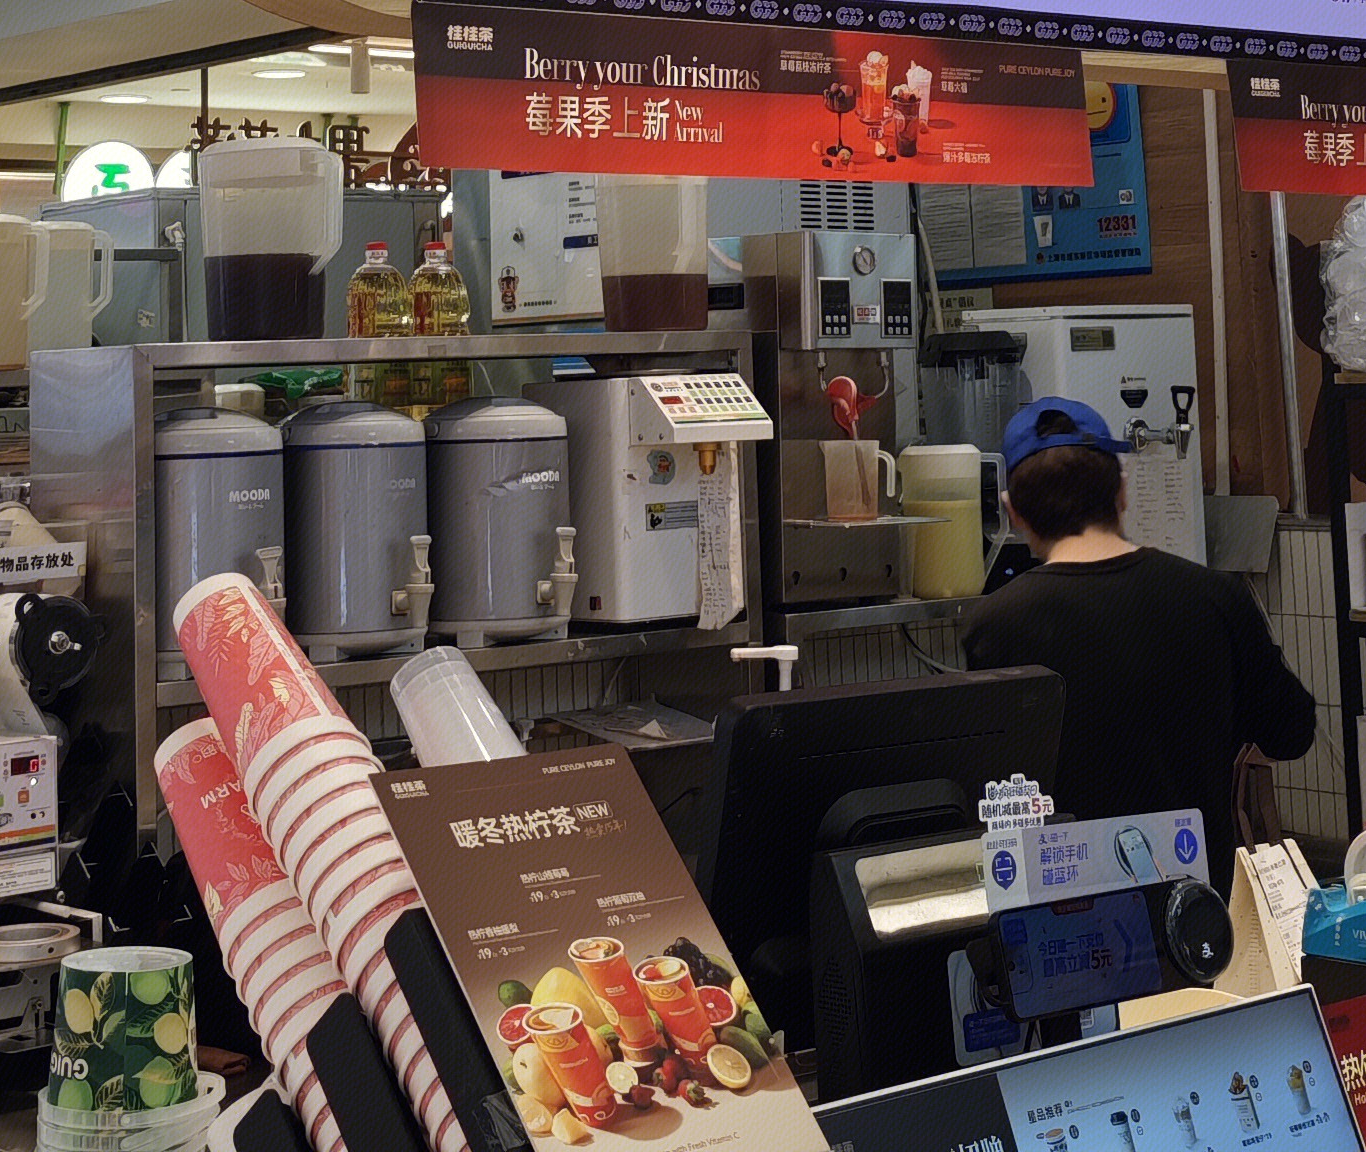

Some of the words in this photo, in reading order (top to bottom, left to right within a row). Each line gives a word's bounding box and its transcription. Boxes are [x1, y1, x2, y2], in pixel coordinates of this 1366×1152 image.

[446, 24, 494, 43] 桂桂茶
[523, 47, 591, 90] Berry
[593, 58, 648, 90] your
[651, 52, 761, 92] Christmas
[524, 92, 671, 142] 莓果季上新
[673, 100, 704, 120] New
[1300, 94, 1338, 126] Berry
[673, 119, 724, 145] Arrival
[1097, 214, 1137, 233] 12331
[522, 470, 560, 483] MOODA
[229, 488, 271, 503] MOODA
[542, 765, 560, 775] PURE
[586, 759, 604, 769] PURE
[604, 757, 616, 767] JOY
[981, 797, 1053, 819] 随机减最高5元
[448, 805, 582, 849] 暖冬热柠茶
[576, 802, 609, 820] NEW
[1039, 843, 1089, 866] 解锁手机
